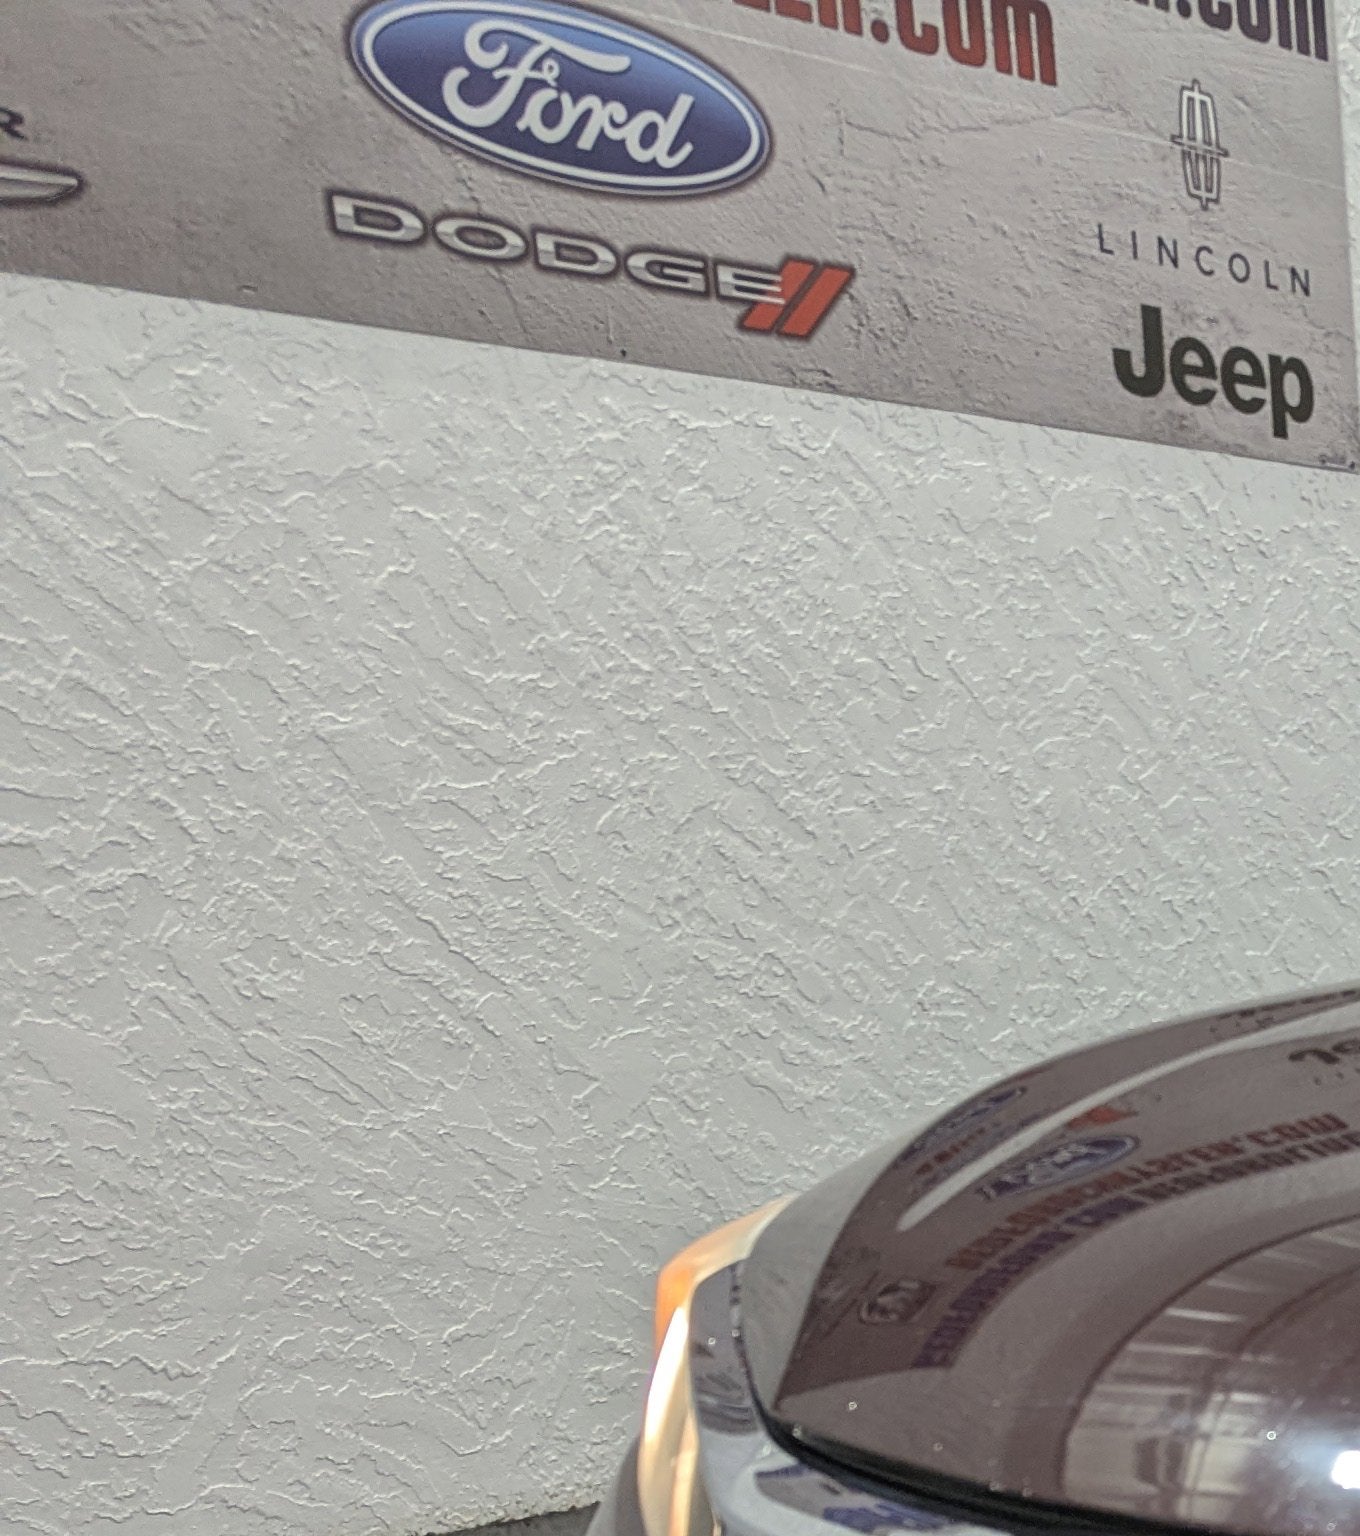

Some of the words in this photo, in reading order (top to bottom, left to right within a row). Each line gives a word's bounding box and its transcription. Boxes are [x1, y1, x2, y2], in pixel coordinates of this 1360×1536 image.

[441, 18, 695, 169] Ford
[330, 191, 787, 305] DODGE
[1097, 223, 1310, 297] LINCOLN
[1112, 304, 1314, 440] Jeep
